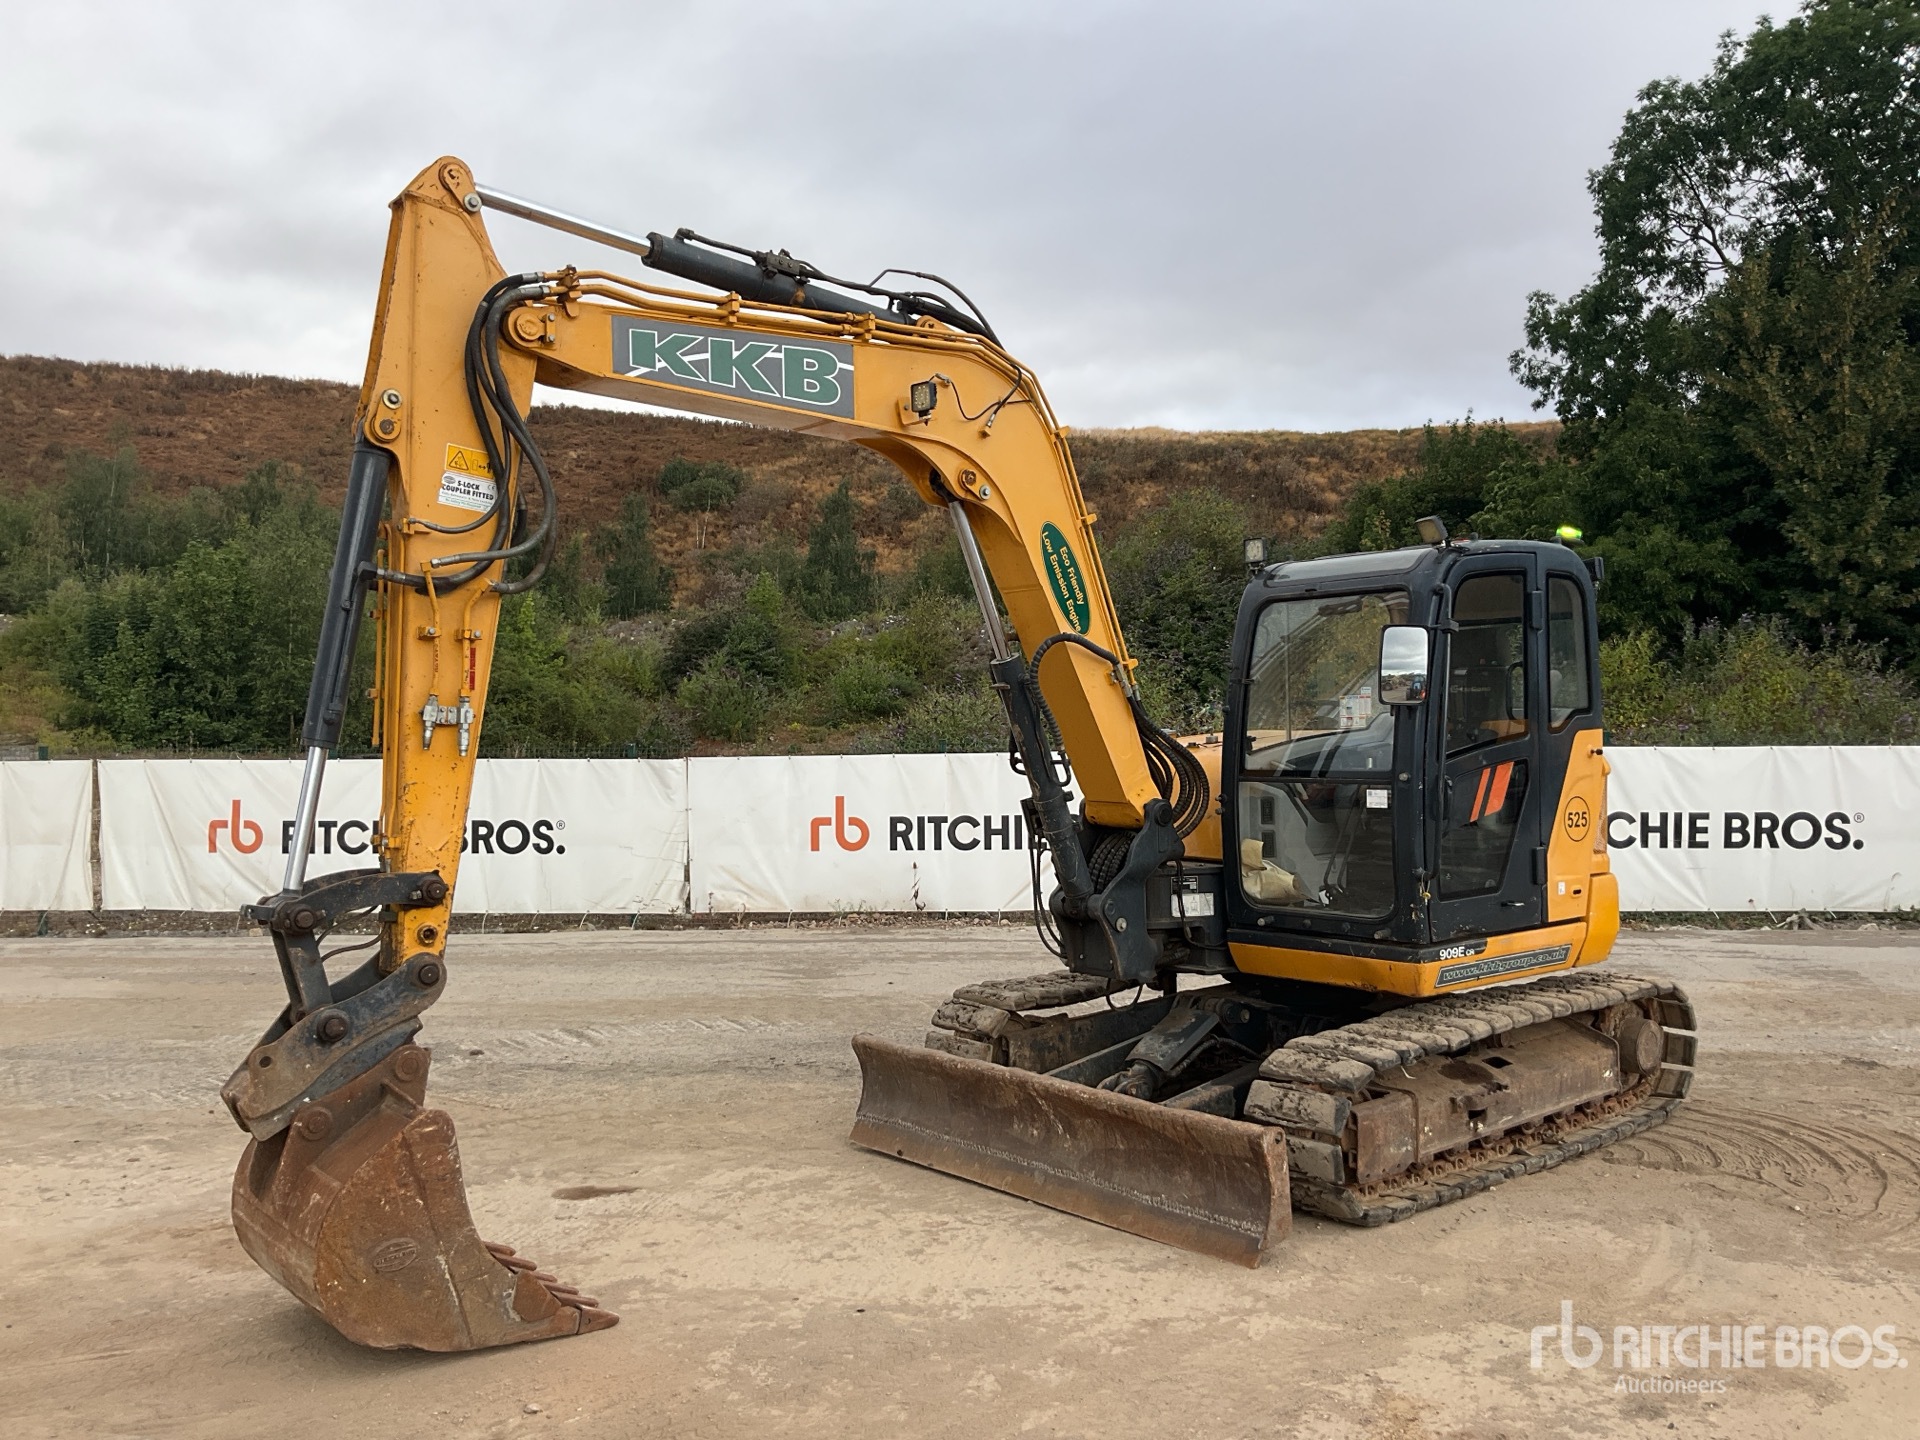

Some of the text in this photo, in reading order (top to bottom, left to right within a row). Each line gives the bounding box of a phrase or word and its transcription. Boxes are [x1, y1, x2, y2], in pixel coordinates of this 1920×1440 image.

[628, 328, 841, 406] KKB
[442, 484, 471, 497] COUPLER
[472, 489, 495, 501] FITTED
[457, 480, 480, 491] S-LOCK
[1041, 531, 1082, 632] Low Emission Engine
[1059, 546, 1085, 605] Eco Friendly
[207, 799, 264, 854] rb
[809, 795, 870, 852] rb
[1567, 811, 1588, 828] 525
[1607, 811, 1710, 850] CHIE
[1439, 946, 1466, 960] 909E
[1443, 946, 1566, 981] www.kkbgroup.co.uk
